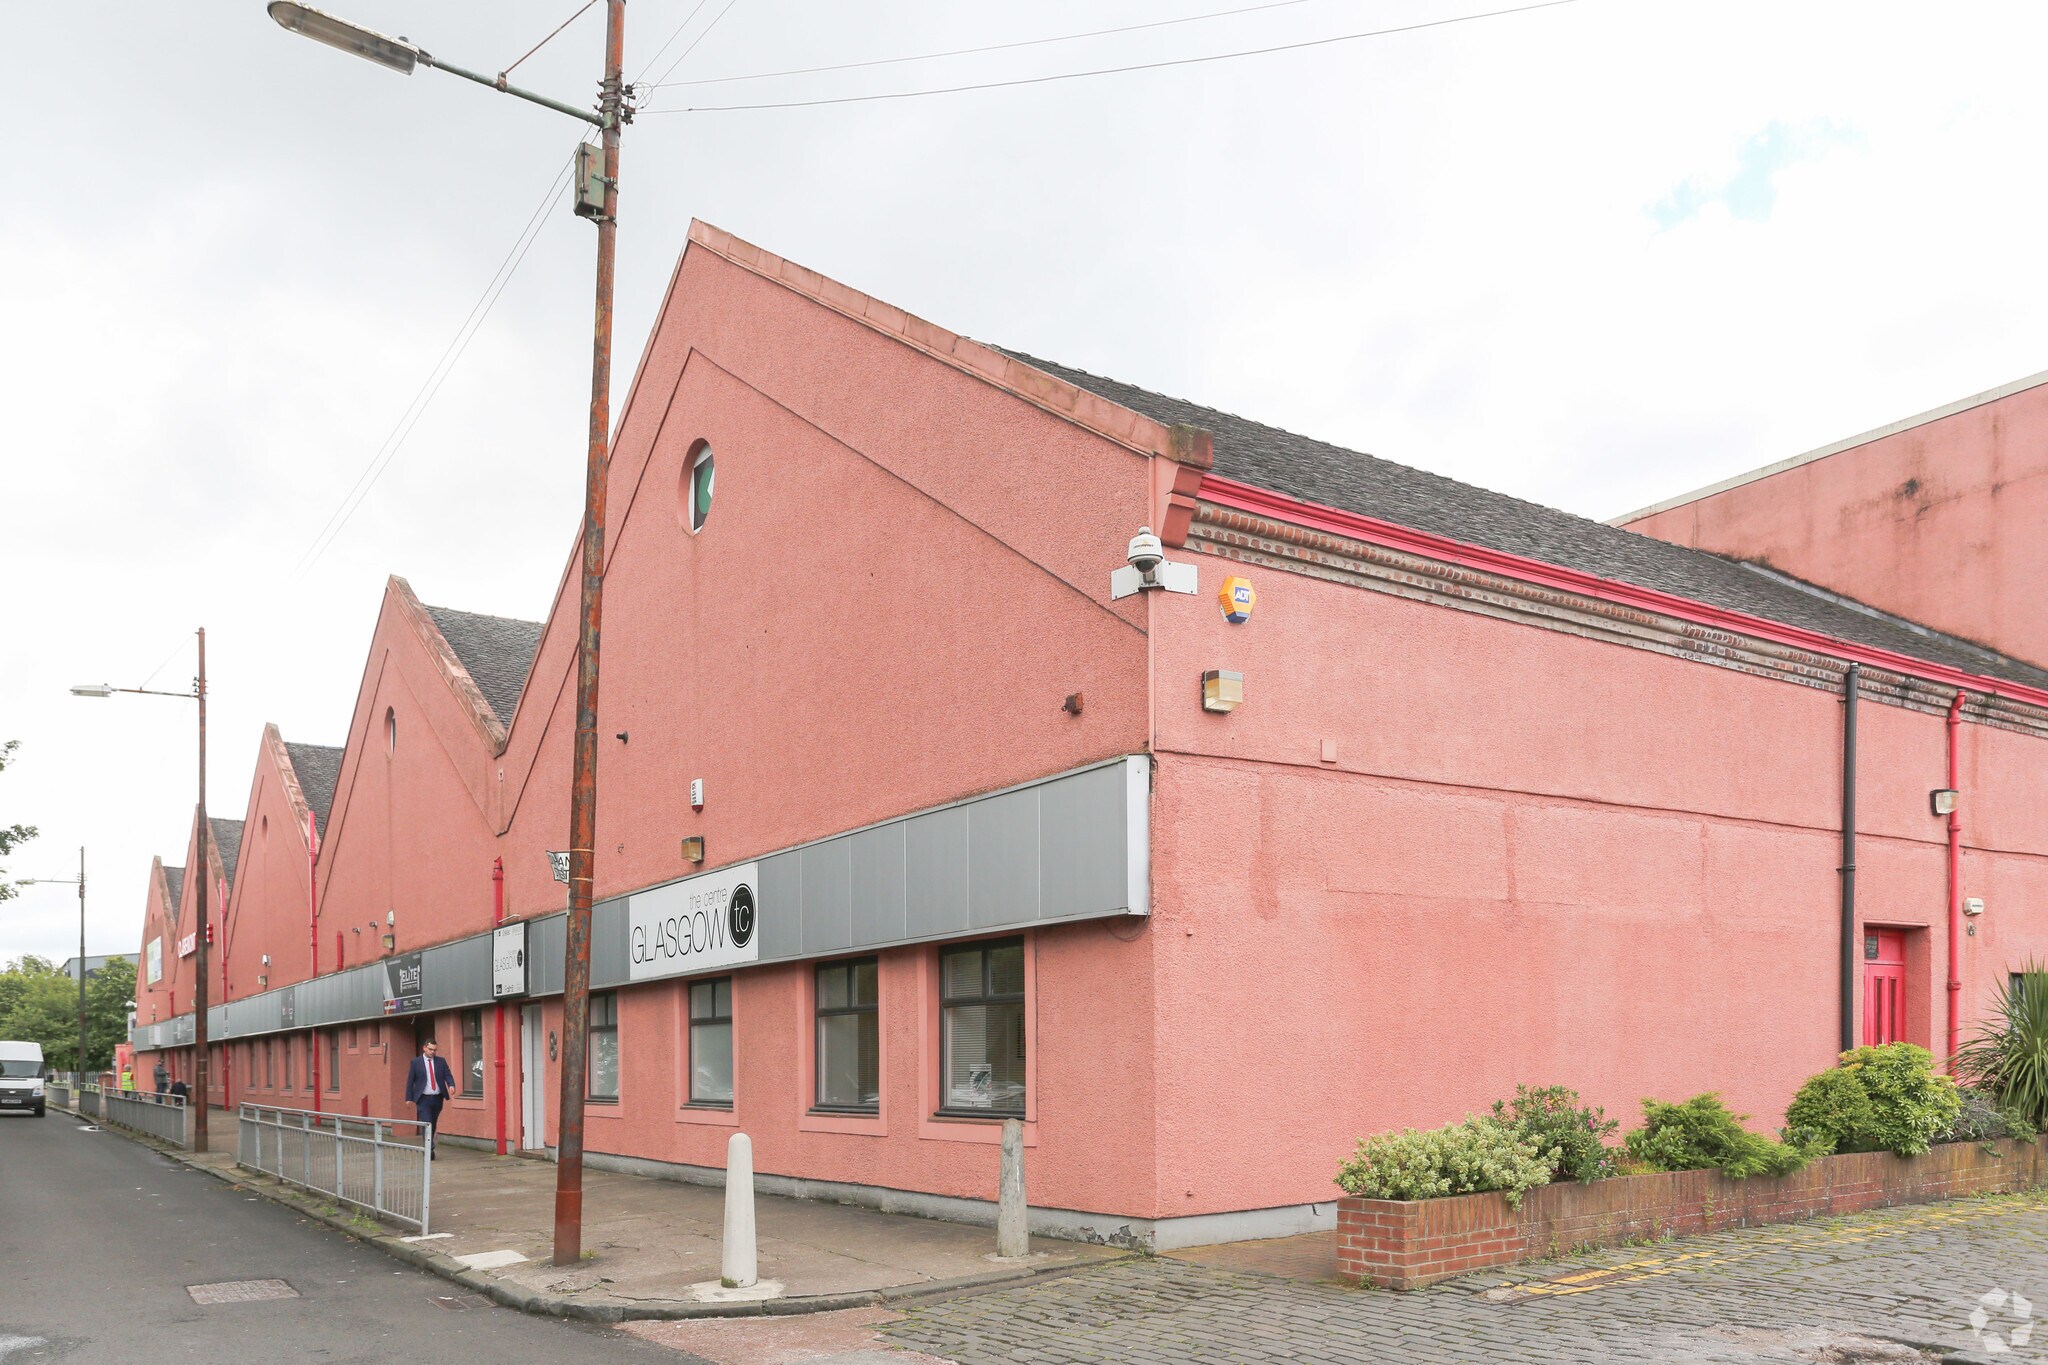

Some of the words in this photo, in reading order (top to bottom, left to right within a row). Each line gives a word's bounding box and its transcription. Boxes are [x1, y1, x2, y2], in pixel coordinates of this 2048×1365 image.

[1235, 589, 1249, 602] ADT
[689, 893, 701, 910] the
[703, 887, 728, 907] centre
[631, 906, 728, 964] GLASGOW
